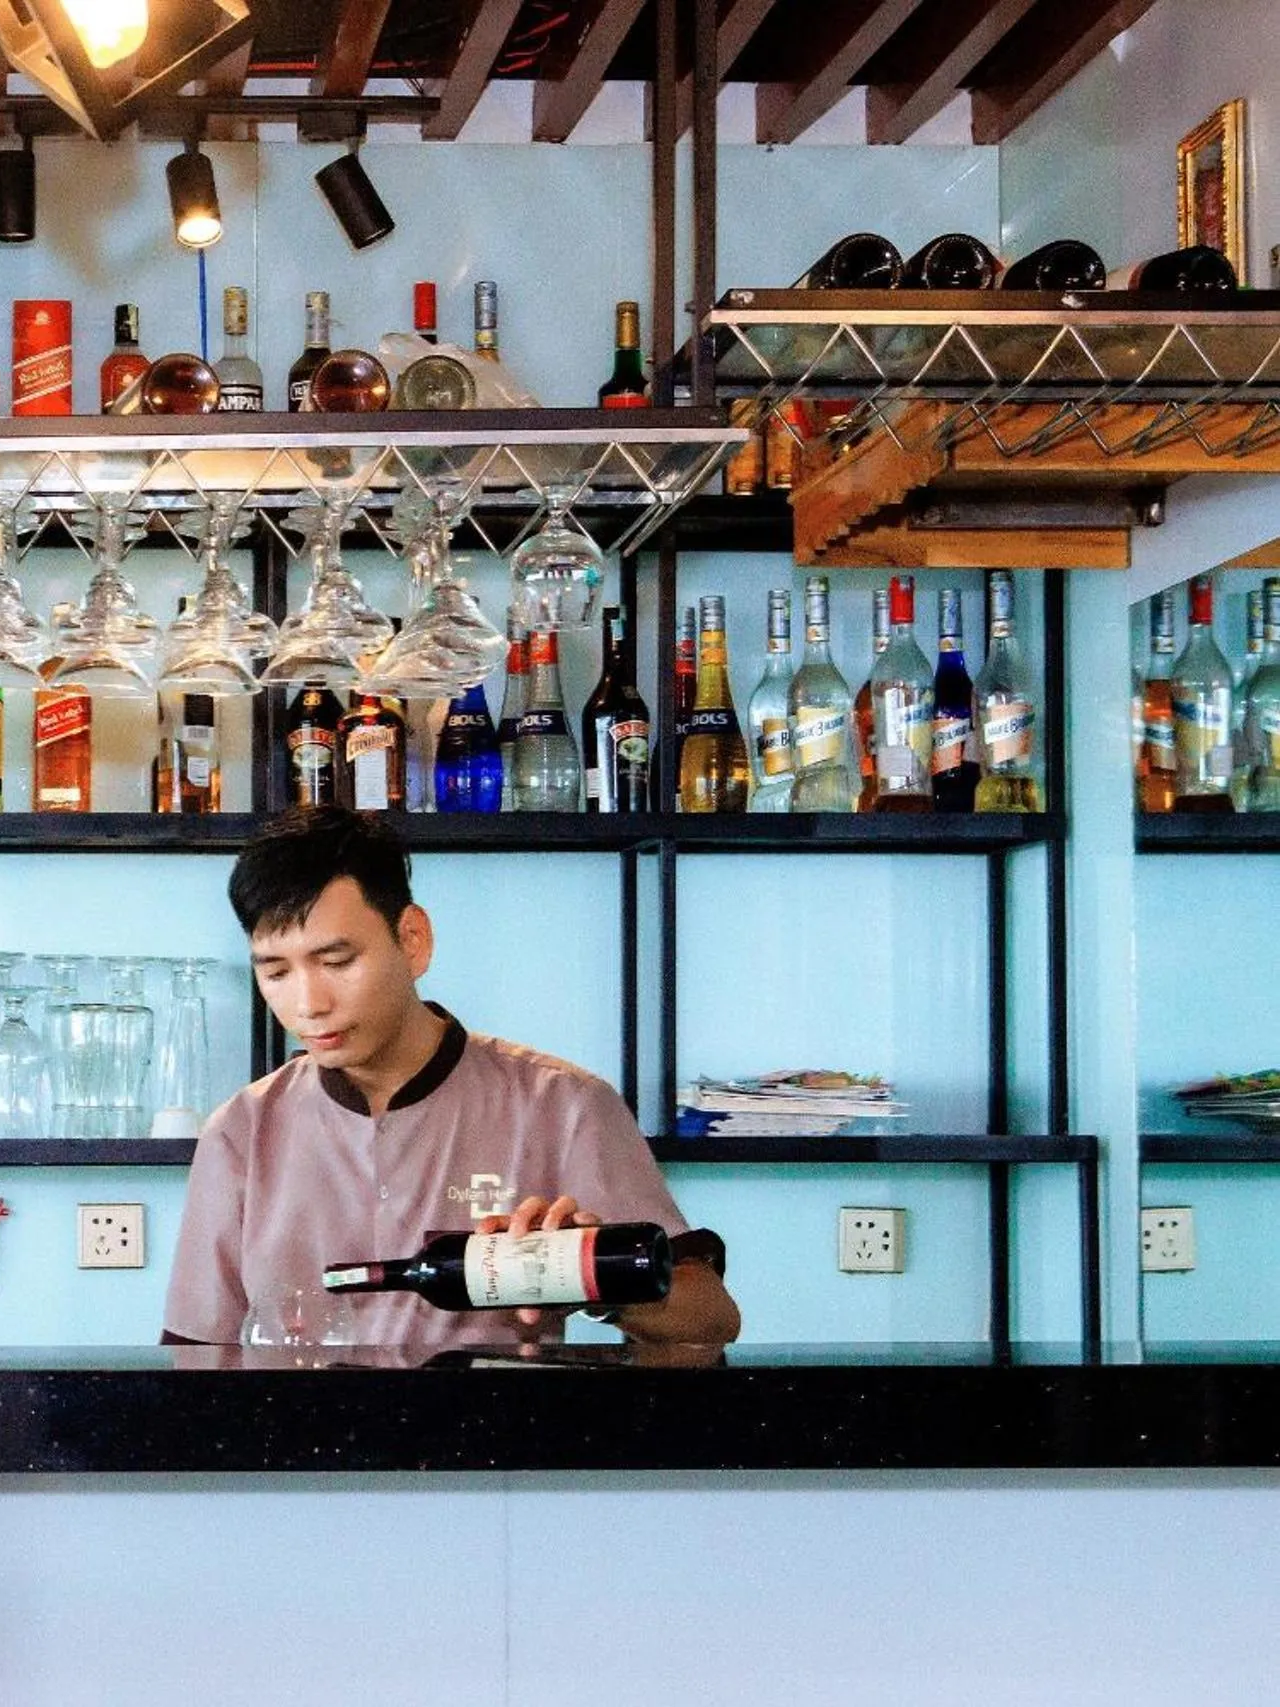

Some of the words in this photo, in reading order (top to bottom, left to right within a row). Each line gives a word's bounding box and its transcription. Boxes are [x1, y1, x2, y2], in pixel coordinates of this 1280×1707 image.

[217, 395, 261, 411] AMPA
[448, 714, 486, 727] BOLS
[691, 713, 728, 727] BOLS
